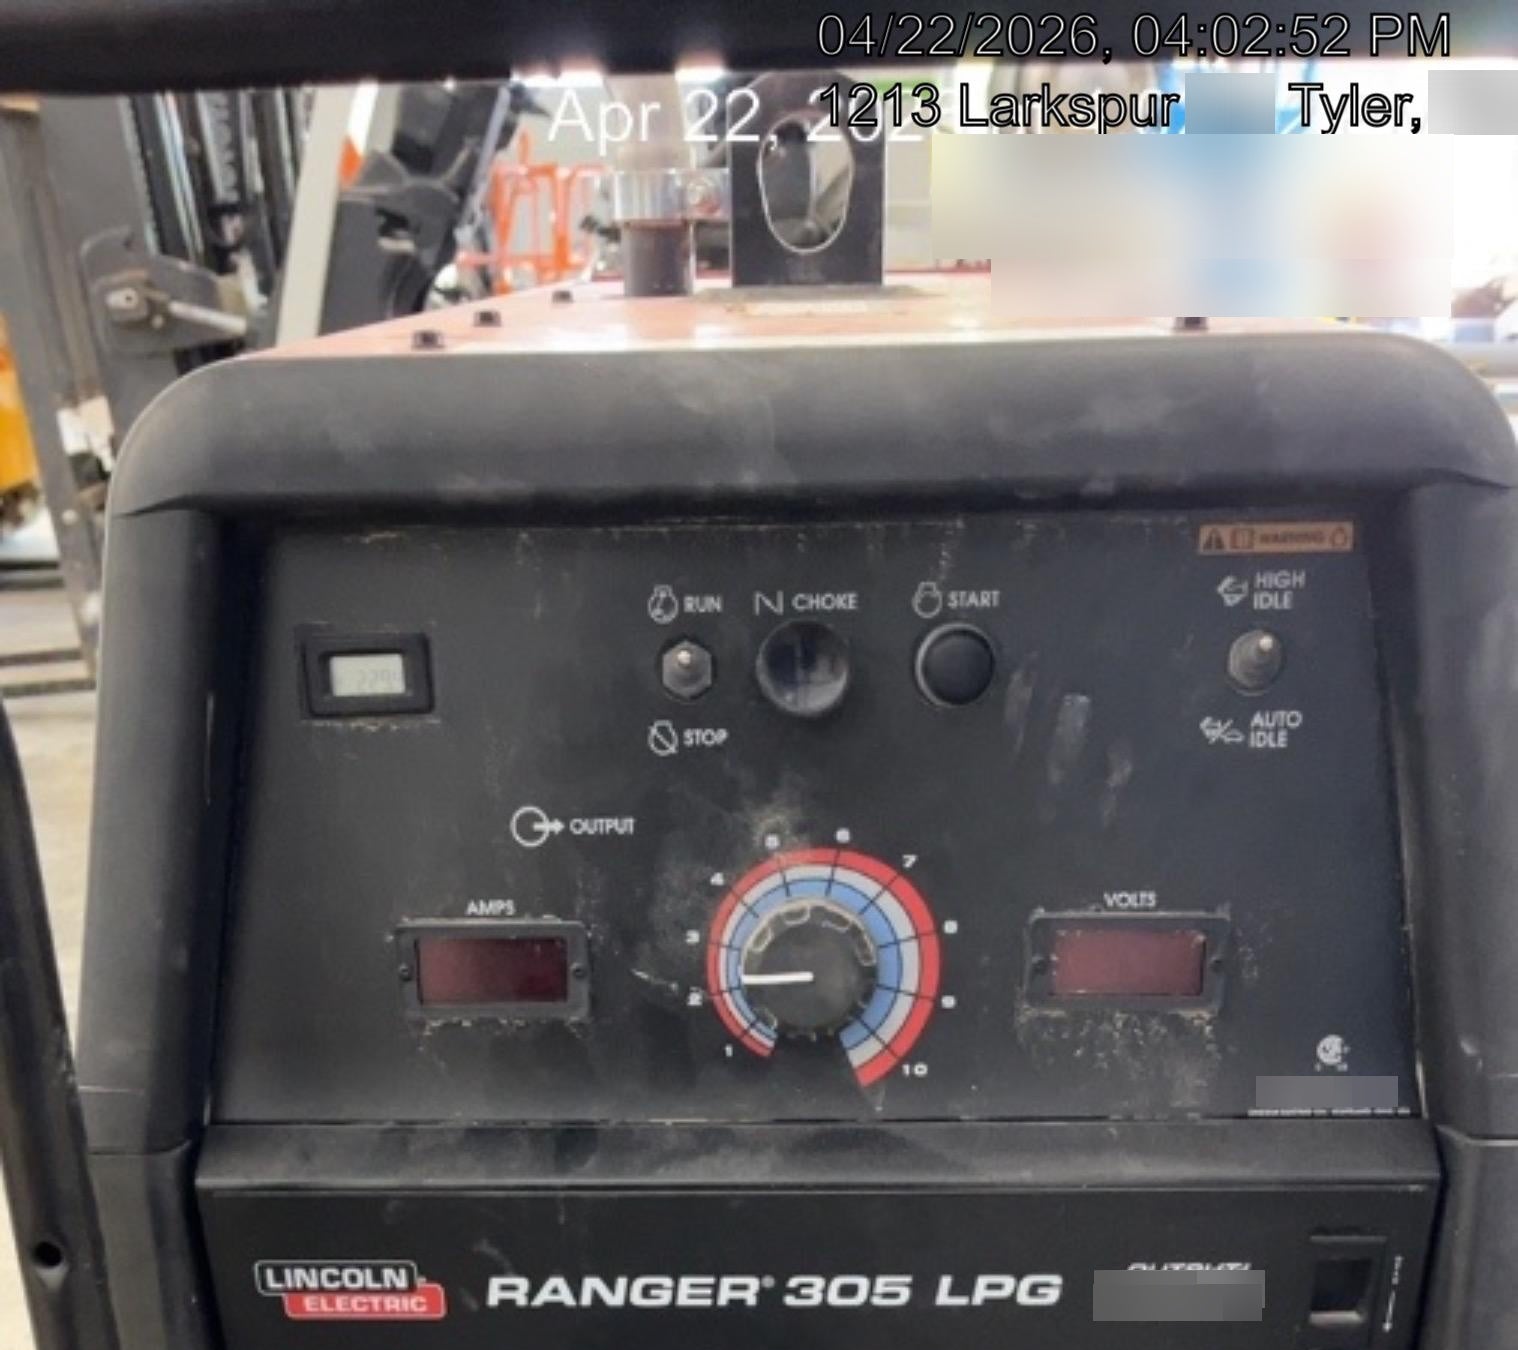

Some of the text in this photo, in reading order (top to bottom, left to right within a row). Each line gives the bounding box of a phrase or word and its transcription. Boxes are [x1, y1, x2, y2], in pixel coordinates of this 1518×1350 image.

[1255, 569, 1306, 589] HIGH
[683, 595, 722, 613] RUN
[792, 592, 858, 611] CHOKE
[948, 589, 1000, 609] START
[1253, 591, 1293, 609] IDLE
[1250, 710, 1302, 729] AUTO
[683, 728, 728, 747] STOP
[1250, 730, 1288, 748] IDLE
[569, 817, 635, 835] OUTPUT
[902, 854, 918, 868] 7
[710, 871, 725, 886] 4
[466, 899, 515, 915] AMPS
[1103, 891, 1157, 908] VOLTS
[902, 1063, 928, 1077] 10
[266, 1268, 408, 1289] LINCOLN
[783, 1274, 914, 1307] 305
[935, 1274, 1063, 1306] LPG
[304, 1296, 427, 1312] ELECTRIC
